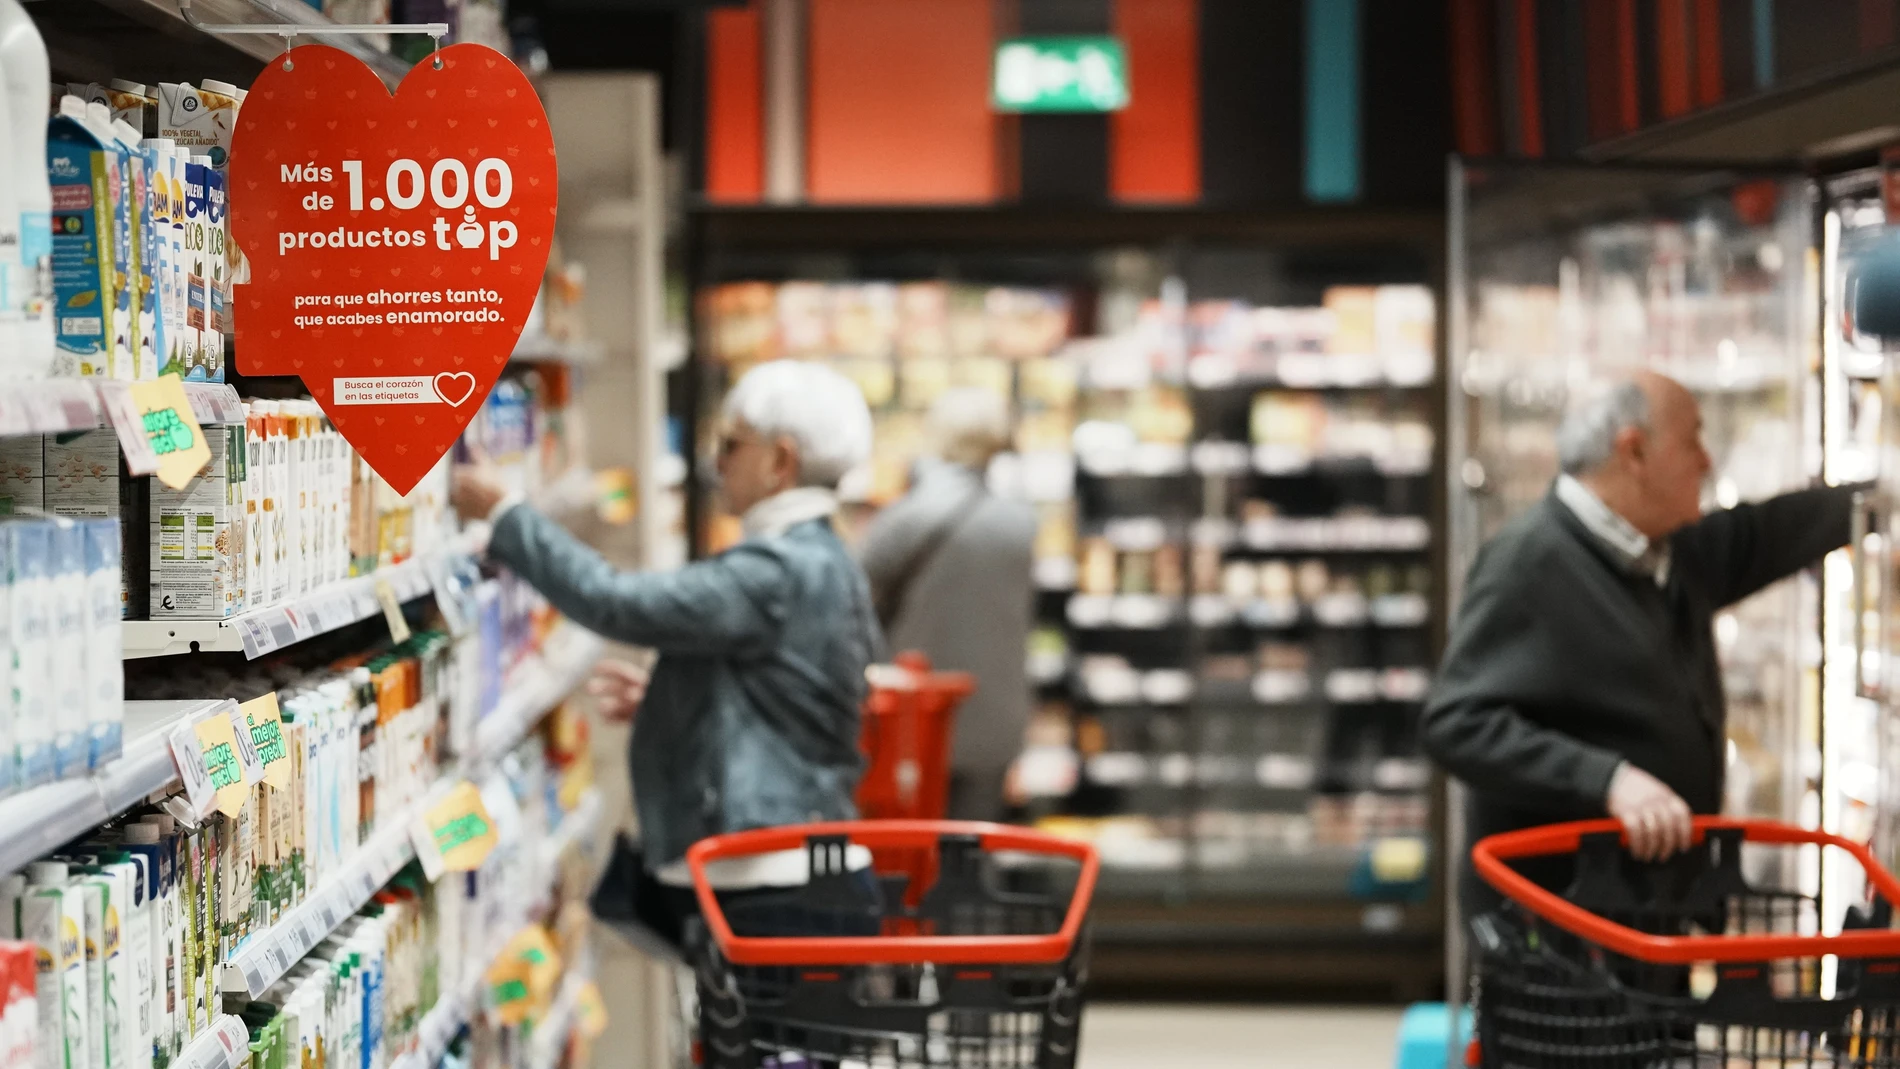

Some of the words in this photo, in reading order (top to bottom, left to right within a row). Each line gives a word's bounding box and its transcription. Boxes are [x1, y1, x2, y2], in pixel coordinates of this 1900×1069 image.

[280, 161, 333, 183] Más
[342, 158, 513, 211] 1.000
[302, 191, 334, 211] de
[279, 226, 426, 256] productos
[294, 294, 331, 309] para
[334, 294, 364, 309] que
[366, 289, 442, 305] ahorres
[446, 288, 503, 304] tanto,
[294, 314, 324, 329] que
[326, 312, 383, 325] acabes
[386, 307, 505, 324] enamorado.
[344, 380, 374, 389] Busca
[375, 380, 384, 388] el
[386, 379, 424, 389] corazón
[359, 392, 373, 400] las
[374, 391, 419, 402] etiquetas
